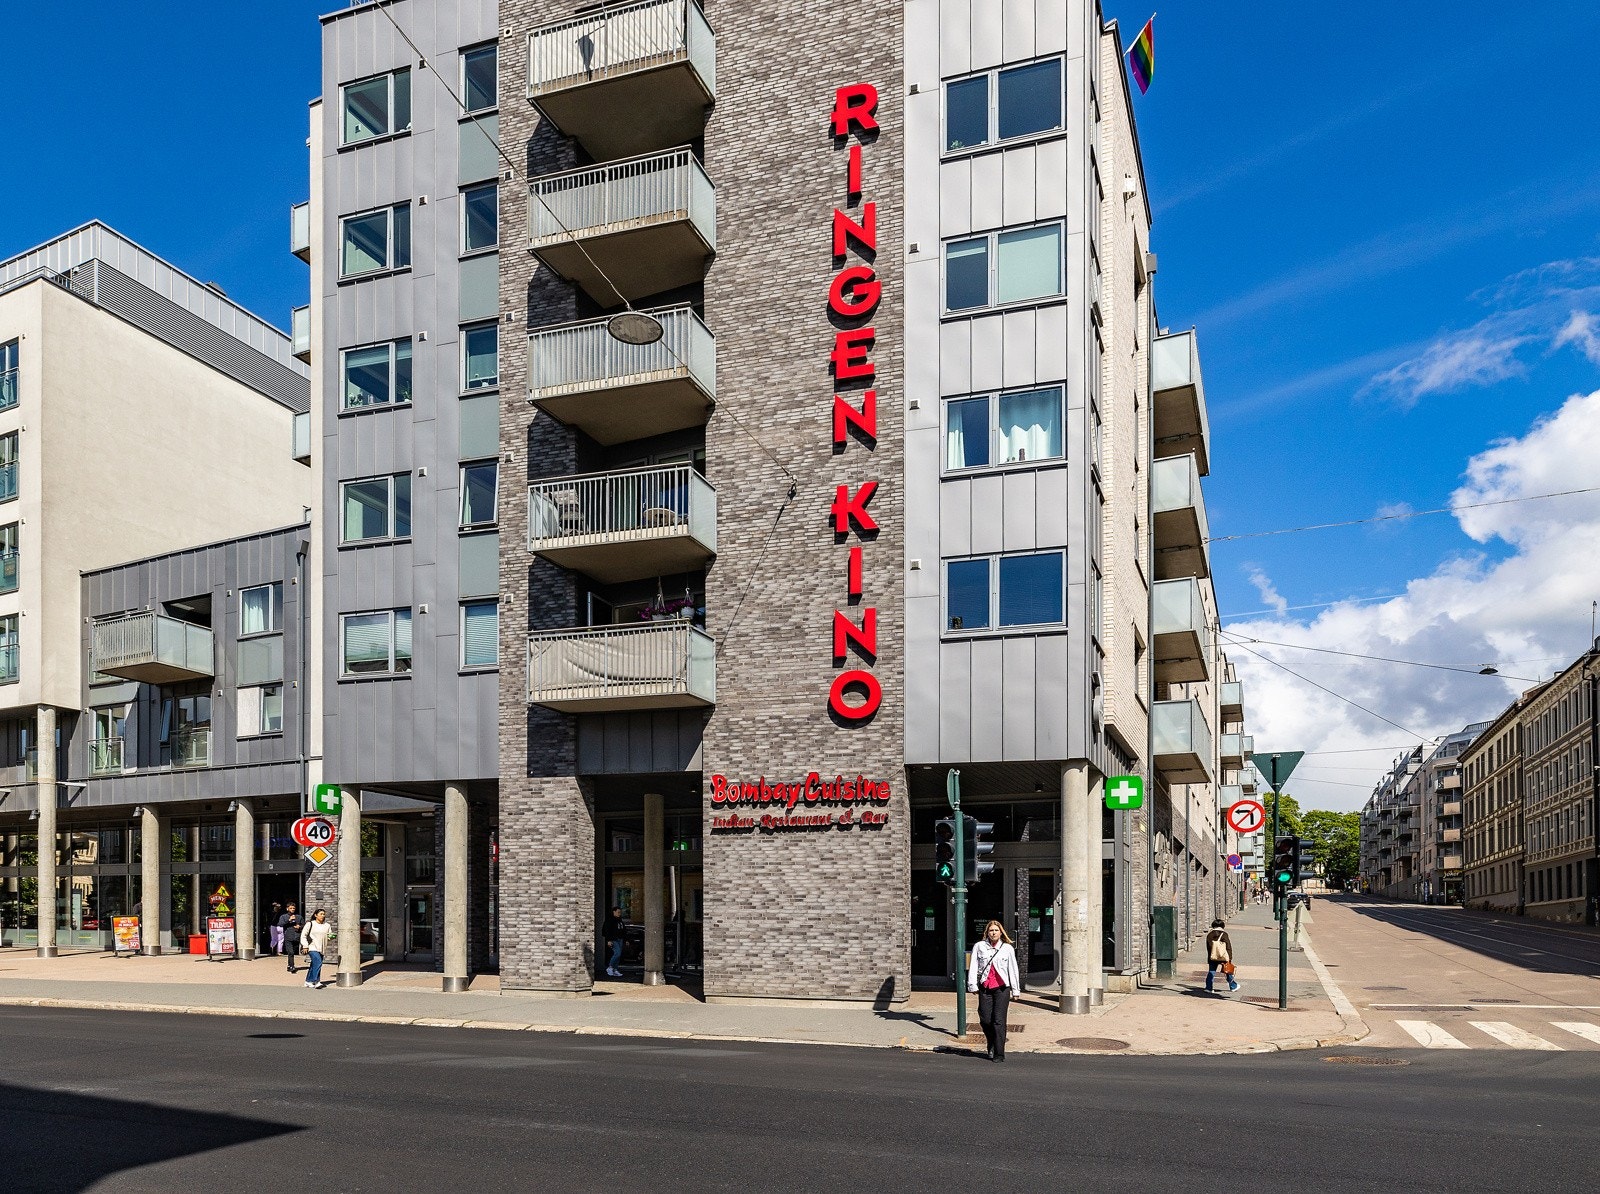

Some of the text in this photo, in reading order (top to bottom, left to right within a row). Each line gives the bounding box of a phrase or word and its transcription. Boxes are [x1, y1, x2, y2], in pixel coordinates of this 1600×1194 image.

[829, 82, 882, 719] RINGEN KINO
[711, 772, 891, 808] Bombay Cuisine
[308, 825, 330, 839] 40
[713, 814, 754, 828] Indian
[760, 813, 832, 829] Restaurant
[861, 811, 889, 824] Bar
